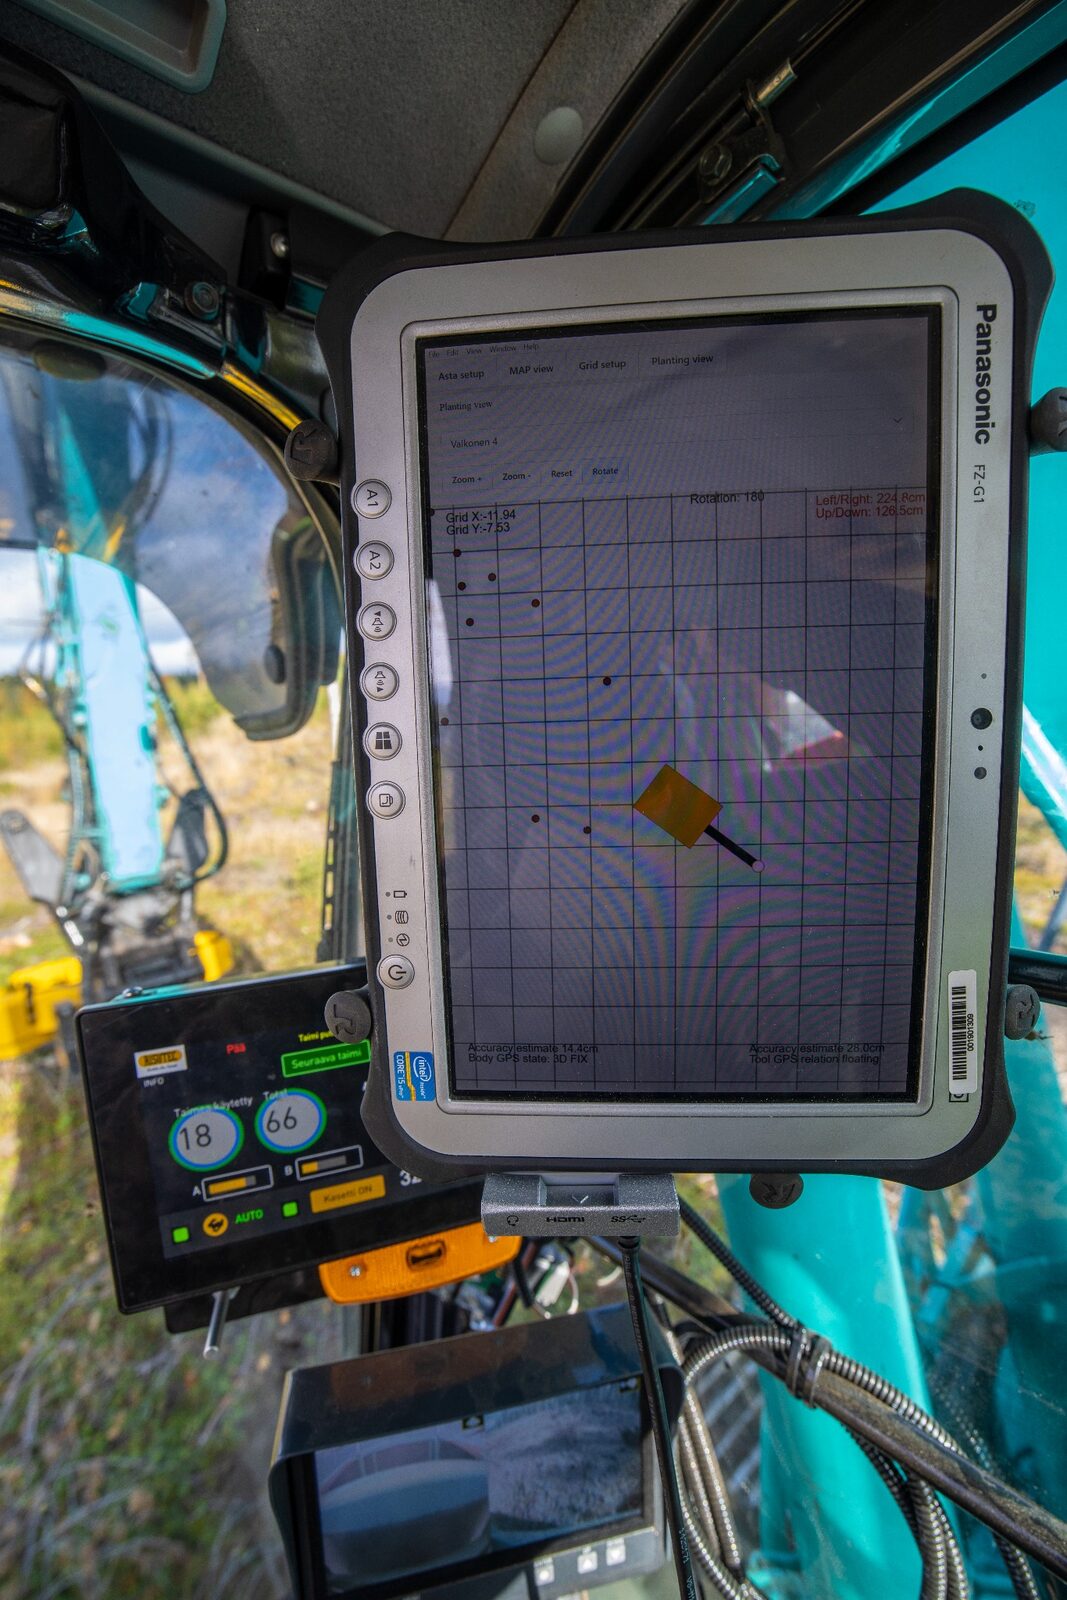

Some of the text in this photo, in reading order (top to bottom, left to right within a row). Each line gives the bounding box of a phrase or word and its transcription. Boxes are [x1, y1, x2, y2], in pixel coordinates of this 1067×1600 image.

[489, 344, 517, 353] Window
[579, 360, 627, 371] Grid setup
[651, 354, 714, 366] Planting view
[438, 370, 485, 380] Asta setup
[509, 365, 554, 375] MAP view
[975, 303, 998, 445] Panasonic
[439, 401, 493, 412] Planting view
[502, 473, 526, 481] Zoom
[551, 470, 573, 478] Reset
[452, 476, 475, 484] Zoom
[973, 464, 986, 503] FZ-G1
[366, 488, 379, 506] A1
[690, 491, 764, 504] Rotation: 180
[815, 494, 873, 507] Left/Right:
[445, 513, 468, 524] Grid
[815, 507, 872, 520] Up/Down:
[446, 524, 469, 535] Grid
[369, 550, 381, 570] A2
[966, 1013, 974, 1051] 001901309
[468, 1043, 513, 1054] Accuracy
[516, 1044, 559, 1053] estimate
[749, 1044, 797, 1055] Accuracy
[800, 1044, 844, 1053] estimate
[468, 1053, 493, 1065] Body
[496, 1053, 519, 1063] GPS
[522, 1054, 550, 1064] state:
[570, 1054, 588, 1063] FIX
[750, 1054, 771, 1064] Tool
[773, 1054, 798, 1064] GPS
[266, 1107, 297, 1133] 66
[179, 1123, 212, 1150] 18
[284, 1165, 293, 1176] B
[192, 1187, 202, 1197] A
[234, 1208, 264, 1225] AUTO
